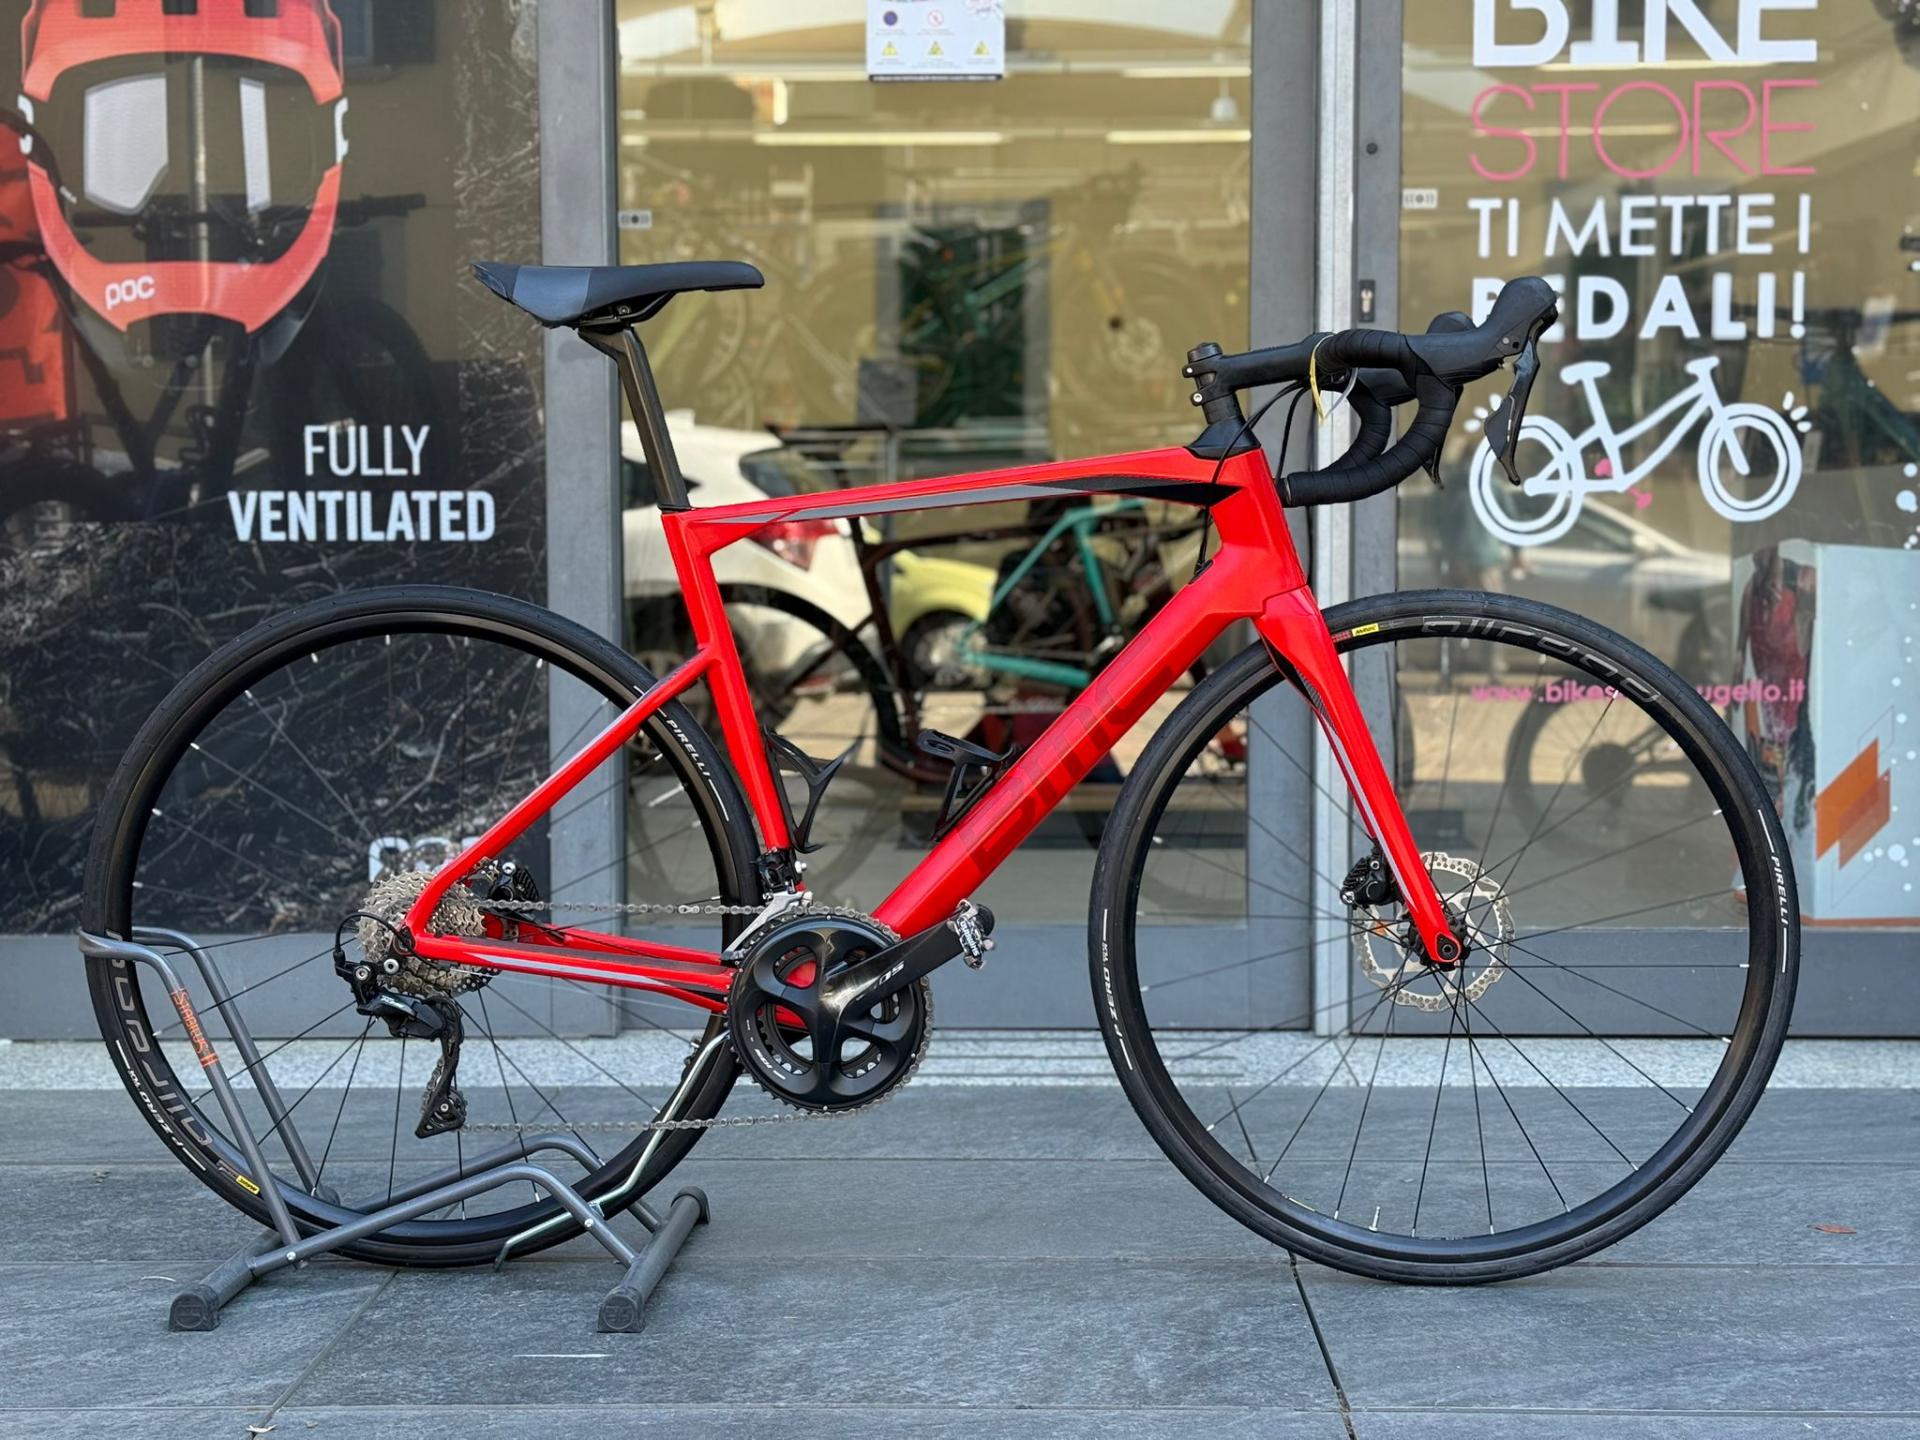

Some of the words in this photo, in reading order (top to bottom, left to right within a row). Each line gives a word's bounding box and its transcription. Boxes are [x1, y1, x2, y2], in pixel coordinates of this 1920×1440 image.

[1469, 78, 1820, 182] STORE
[1468, 197, 1519, 258] TI
[1545, 193, 1775, 257] METTE
[1798, 193, 1811, 254] I
[304, 425, 430, 476] FULLY
[227, 490, 496, 542] VENTILATED
[666, 719, 711, 777] PIRELLI
[1770, 855, 1789, 926] PIRELLI
[1103, 966, 1118, 1021] ZERO
[140, 1091, 174, 1134] ZERO
